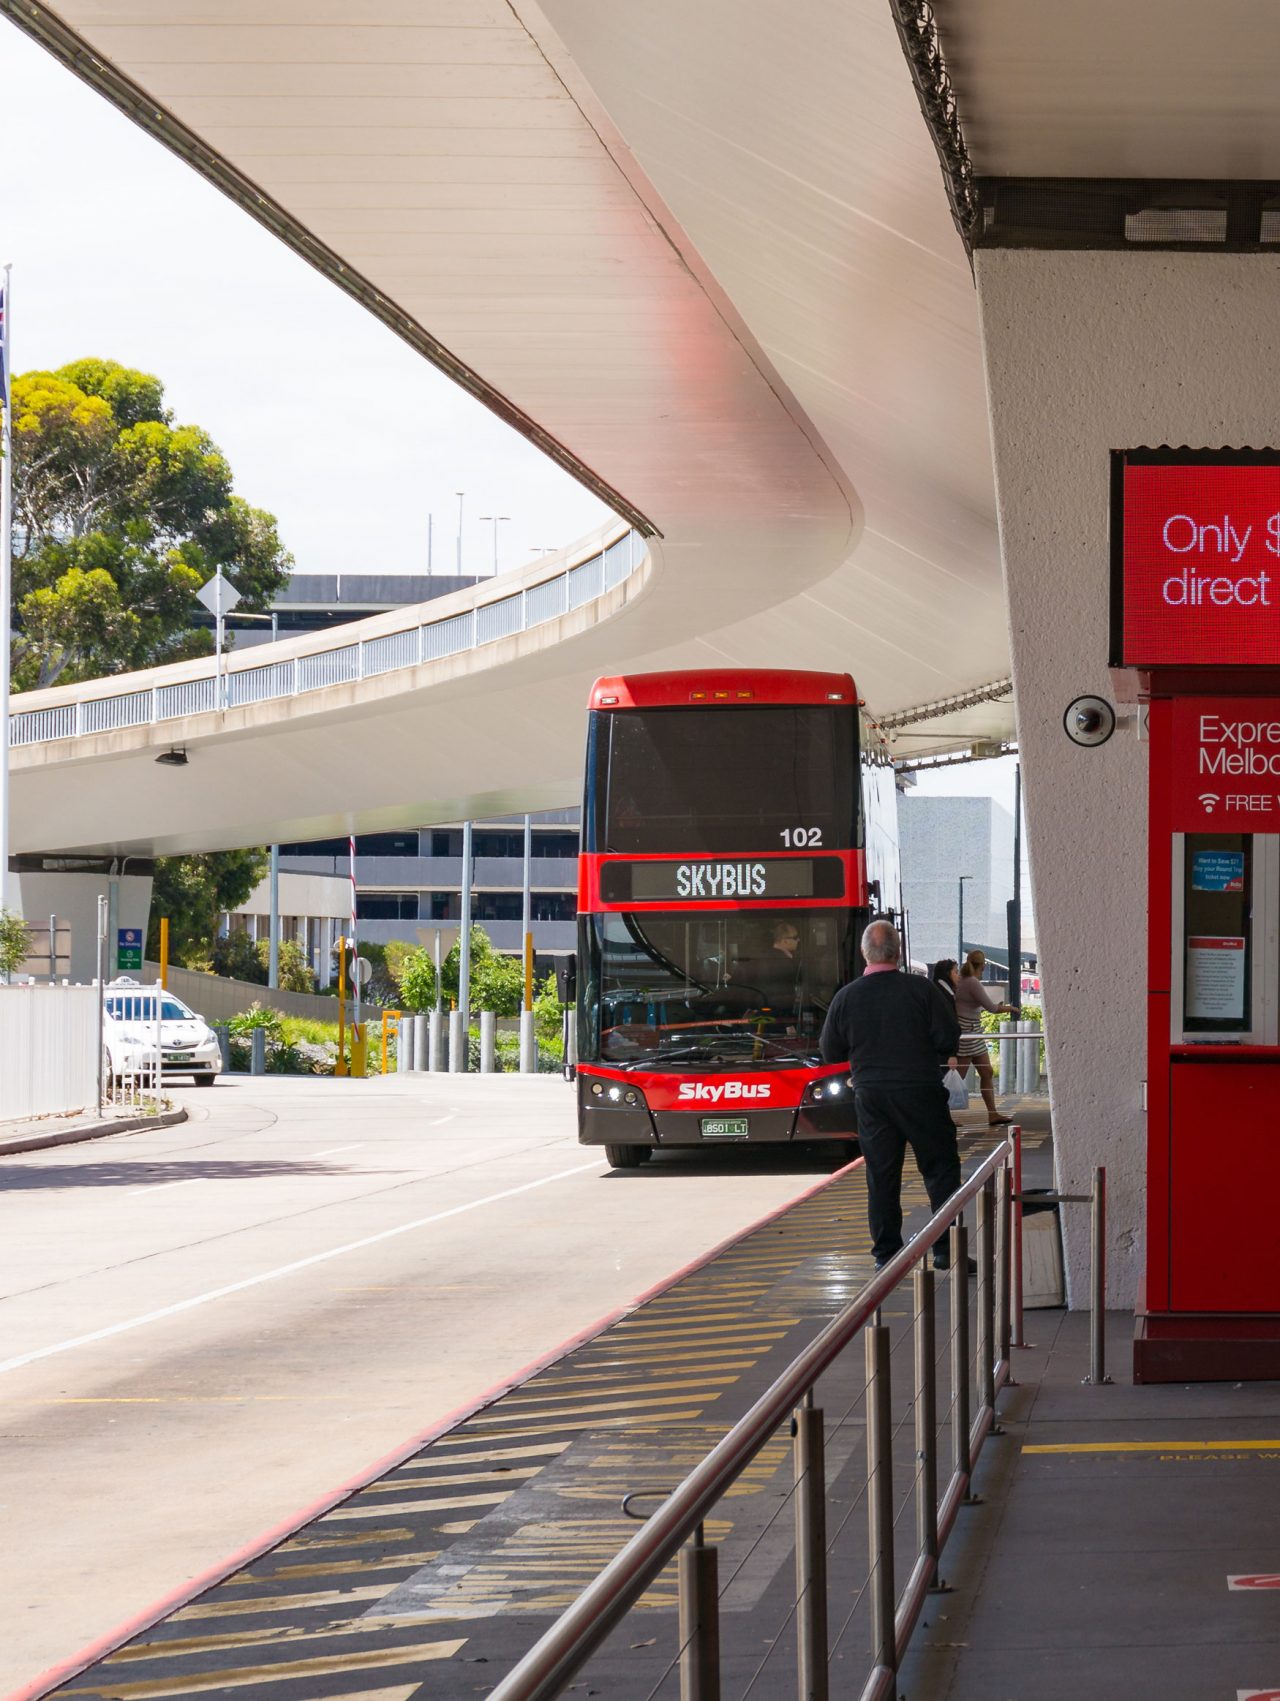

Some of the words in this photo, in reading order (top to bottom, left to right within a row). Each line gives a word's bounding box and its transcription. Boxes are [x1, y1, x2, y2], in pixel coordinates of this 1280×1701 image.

[1163, 514, 1252, 562] Only
[1163, 568, 1271, 605] direct
[1225, 794, 1273, 811] FREE
[780, 827, 823, 848] 102
[676, 864, 766, 897] SKYBUS
[678, 1081, 771, 1102] SkyBus
